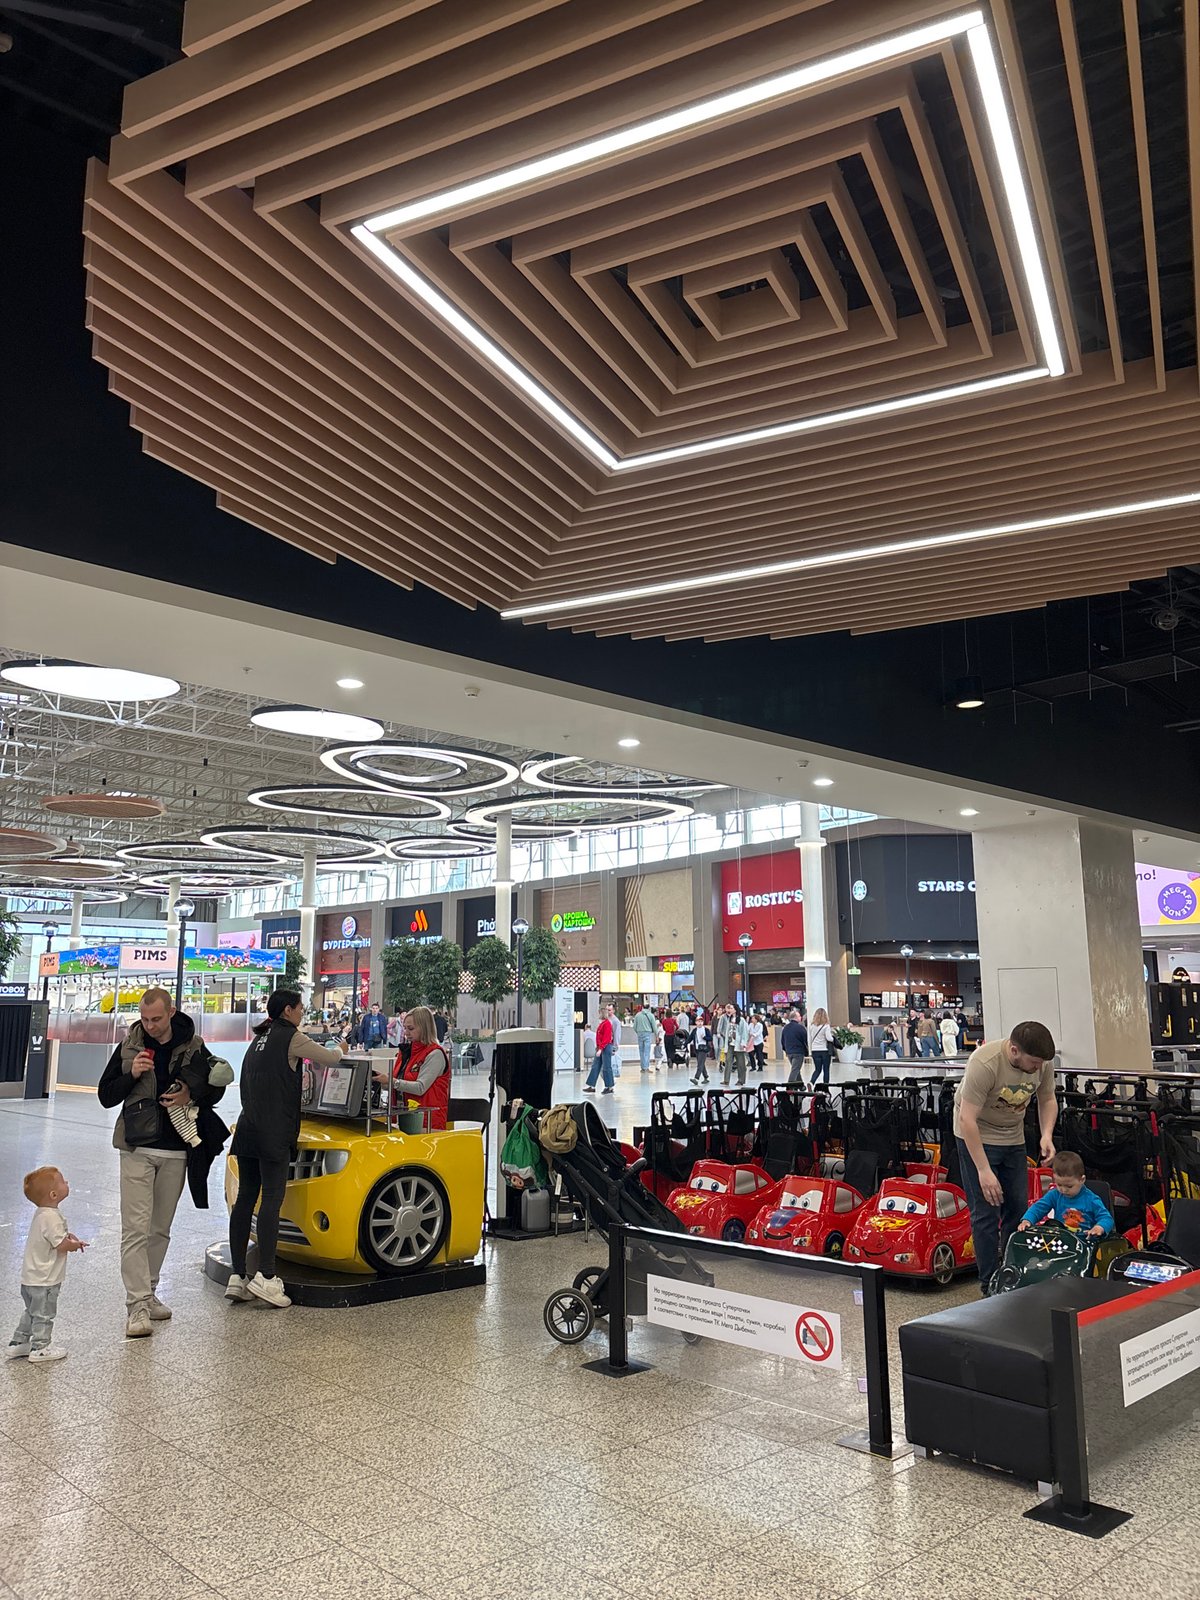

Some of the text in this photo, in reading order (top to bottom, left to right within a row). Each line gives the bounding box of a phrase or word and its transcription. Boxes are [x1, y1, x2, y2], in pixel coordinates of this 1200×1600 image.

[918, 880, 964, 892] STARS
[745, 889, 803, 908] ROSTIC'S
[563, 911, 588, 920] КРОШКА
[563, 918, 596, 928] КАРТОШКА
[323, 939, 350, 950] БУРГЕР
[134, 949, 167, 961] PIMS
[43, 956, 55, 967] PIMS
[663, 960, 694, 972] SUBWAY
